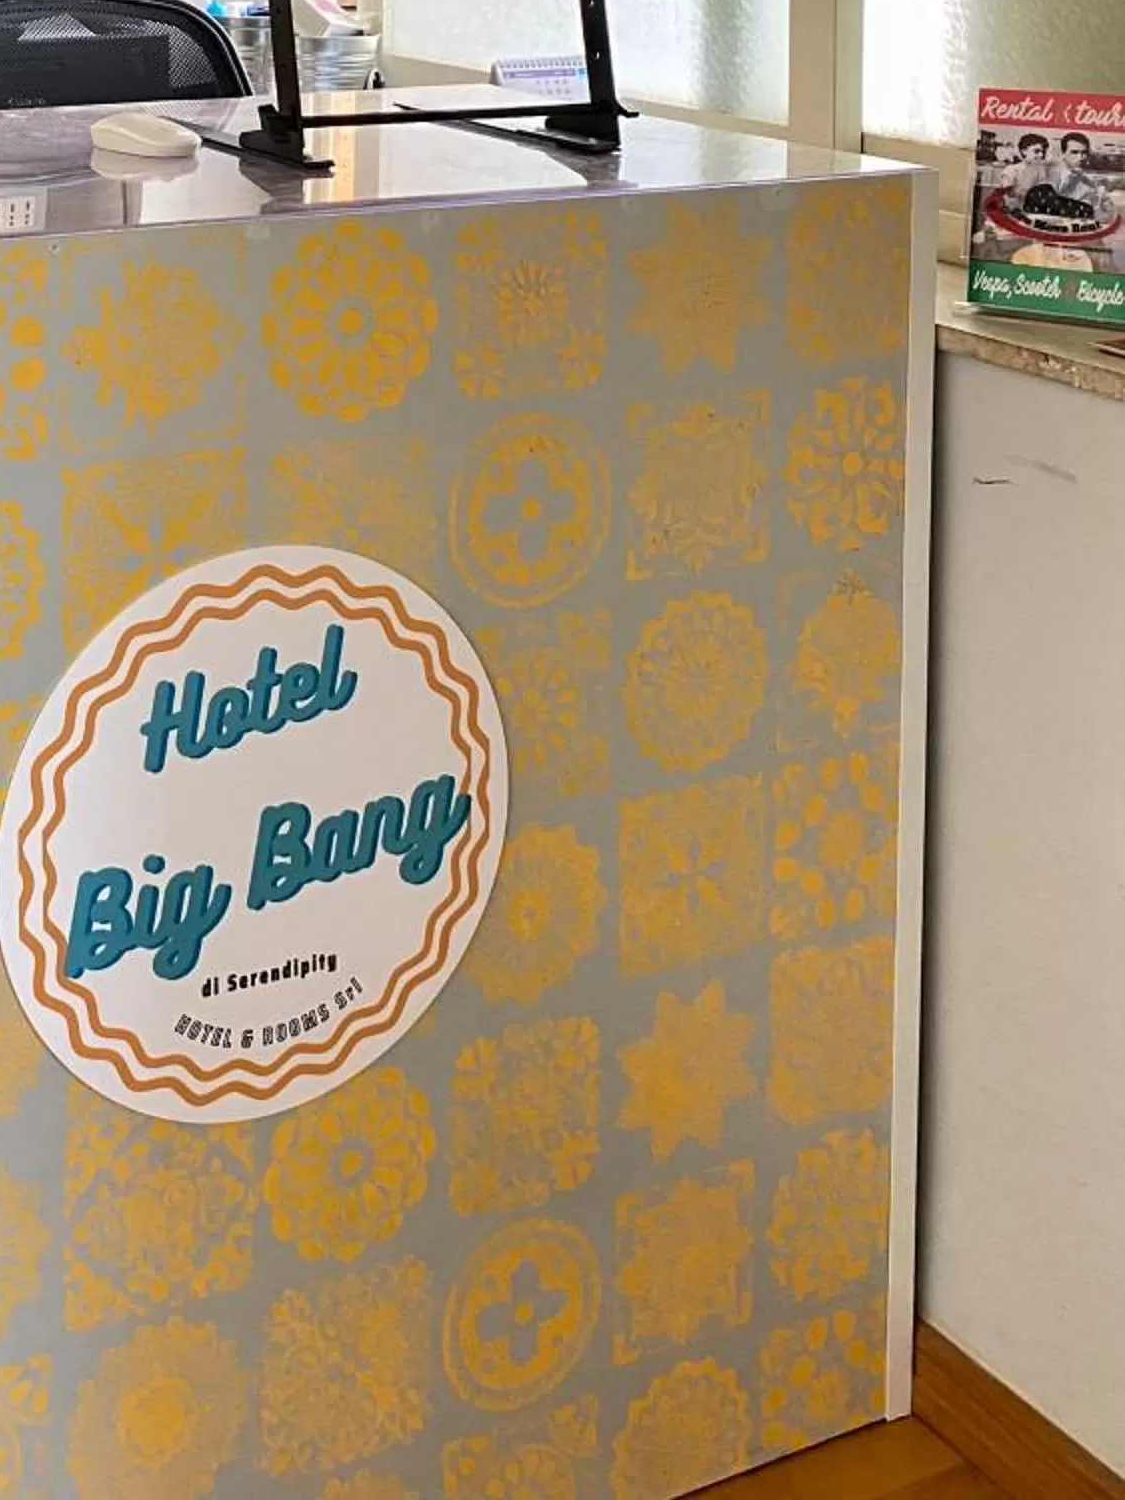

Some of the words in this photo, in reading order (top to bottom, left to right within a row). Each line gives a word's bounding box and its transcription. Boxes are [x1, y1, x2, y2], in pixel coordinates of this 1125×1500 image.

[980, 95, 1055, 122] Rental
[140, 623, 358, 773] Hotel
[64, 855, 232, 980] Big
[247, 774, 472, 911] Bang
[201, 976, 220, 998] di
[227, 953, 338, 992] Serendipity
[174, 1013, 233, 1049] HOTEL
[240, 1028, 255, 1049] &
[262, 1003, 331, 1046] ROOMS
[334, 976, 364, 1010] Srl
